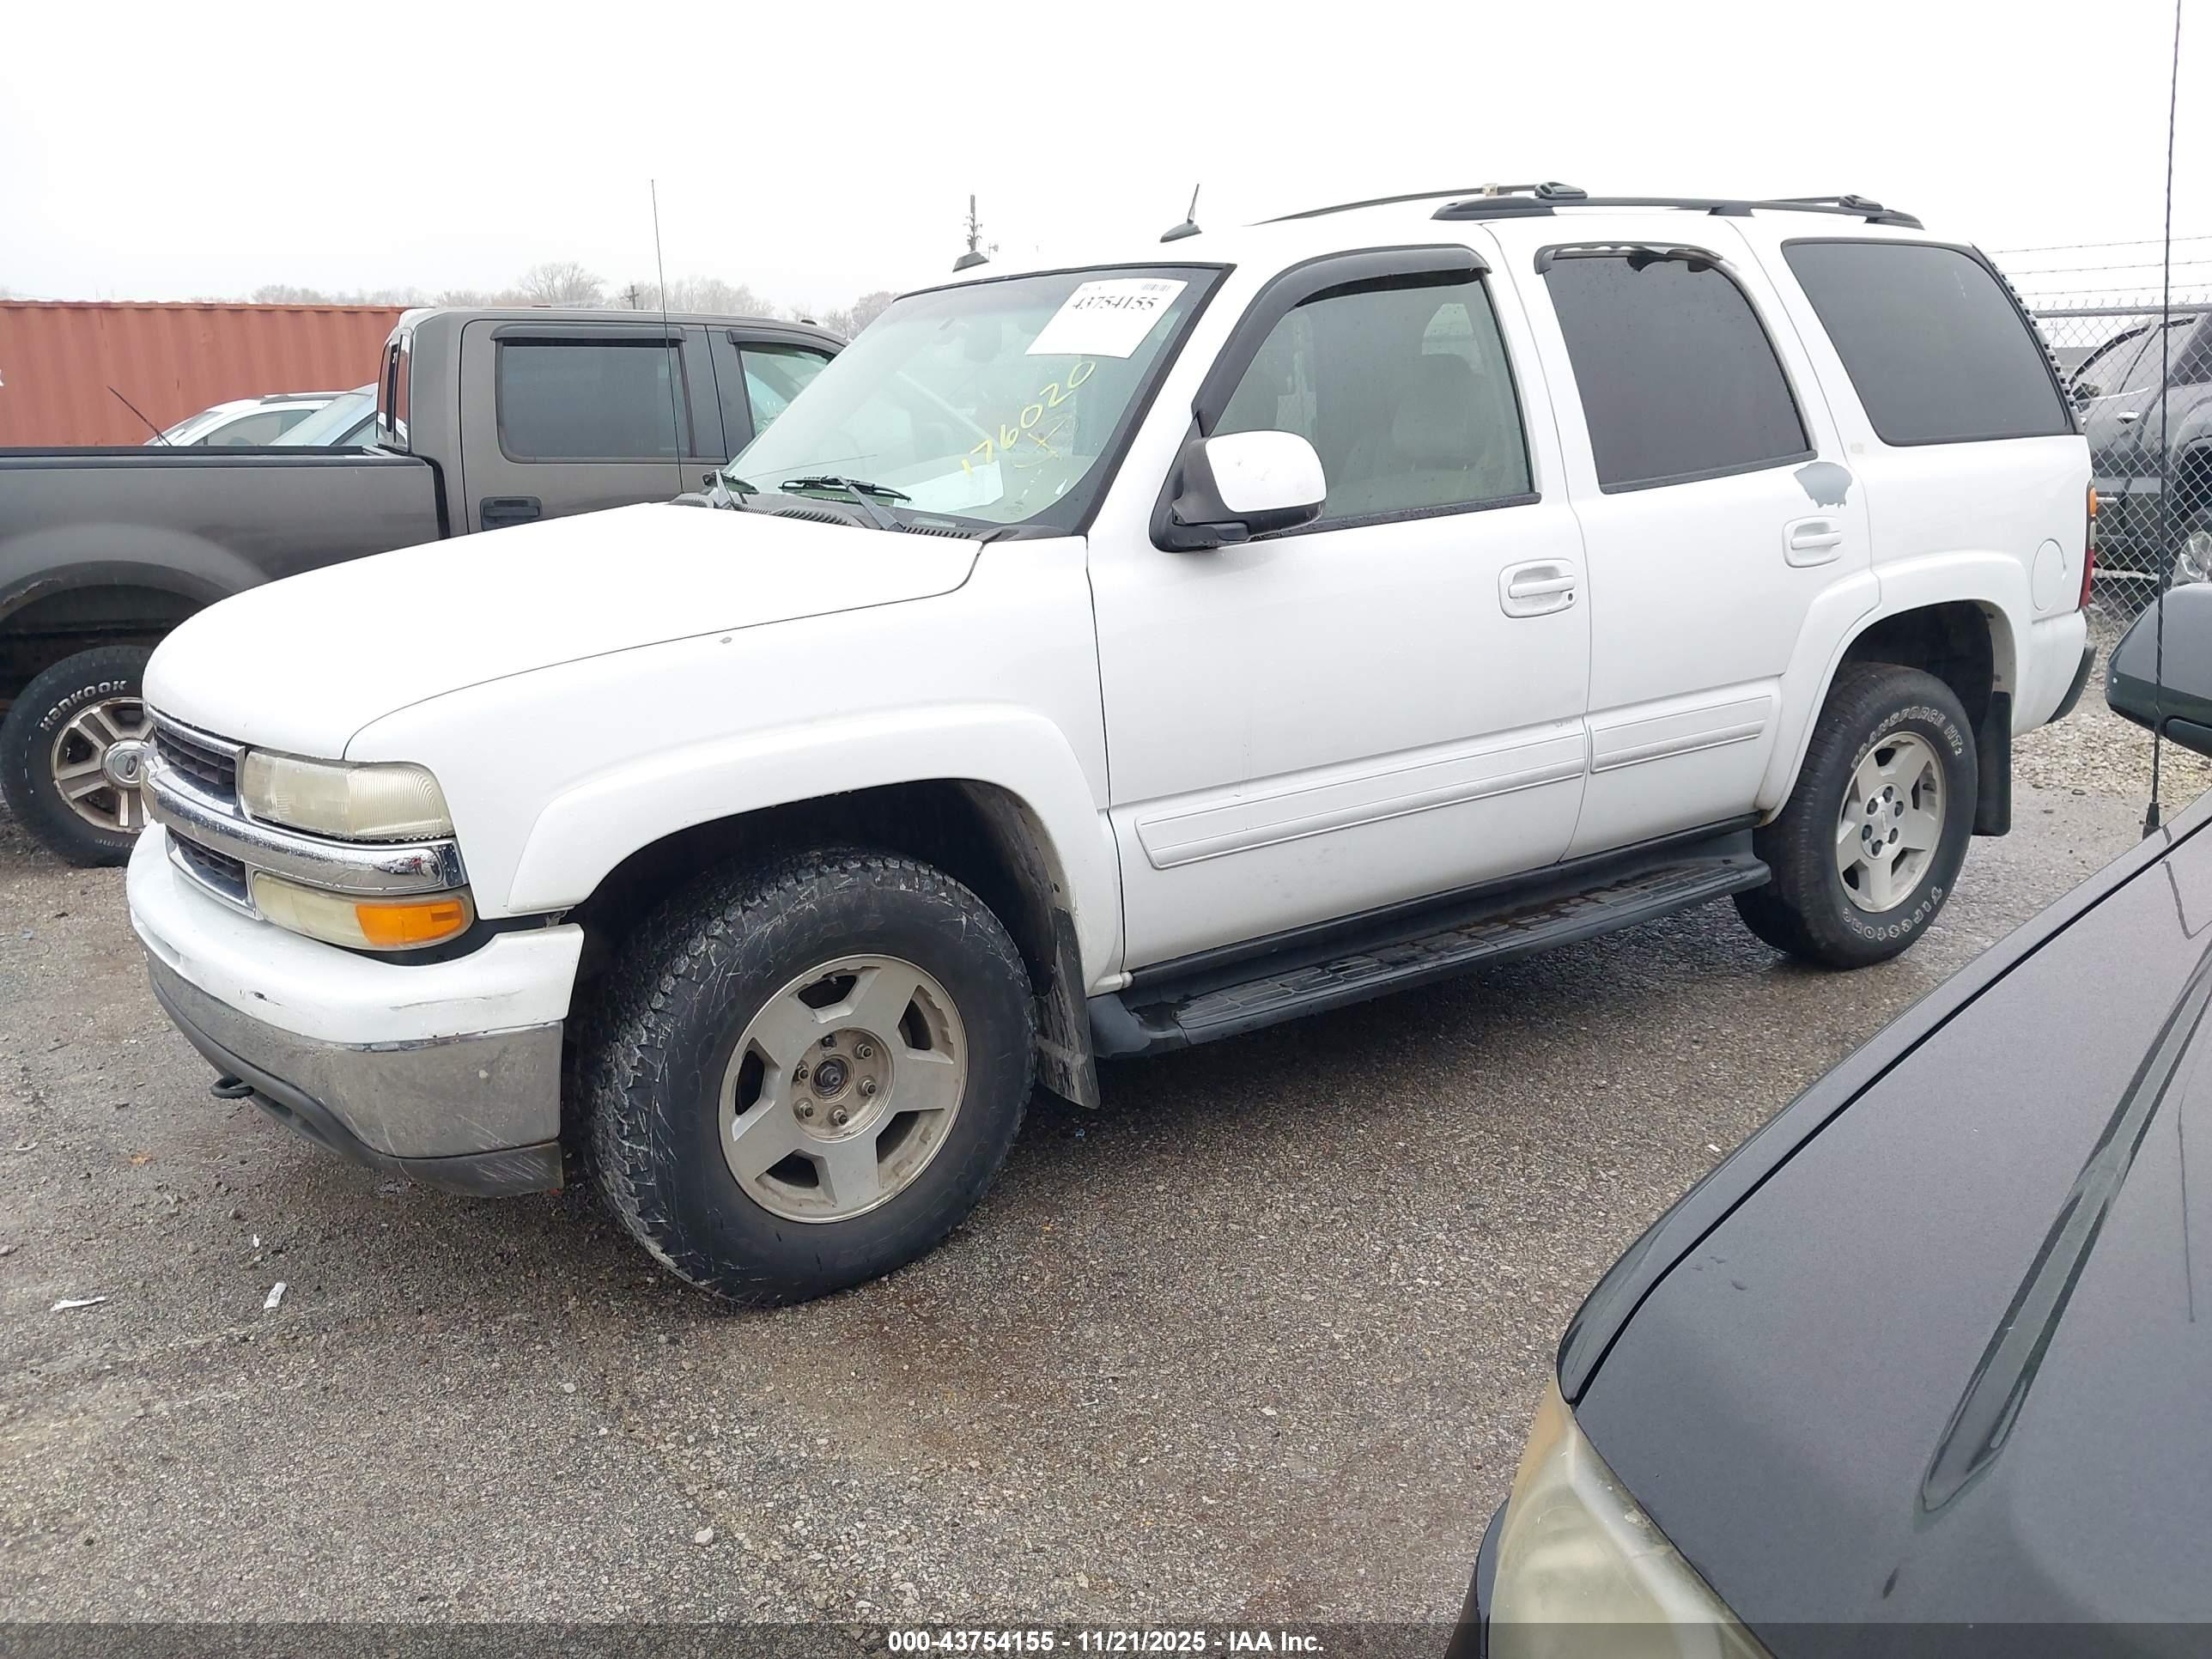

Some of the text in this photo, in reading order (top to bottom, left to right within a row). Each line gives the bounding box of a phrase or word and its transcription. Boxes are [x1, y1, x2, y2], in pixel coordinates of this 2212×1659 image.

[1072, 295, 1159, 310] 43754155
[961, 361, 1097, 476] 176020
[1842, 885, 1943, 942] Firestone
